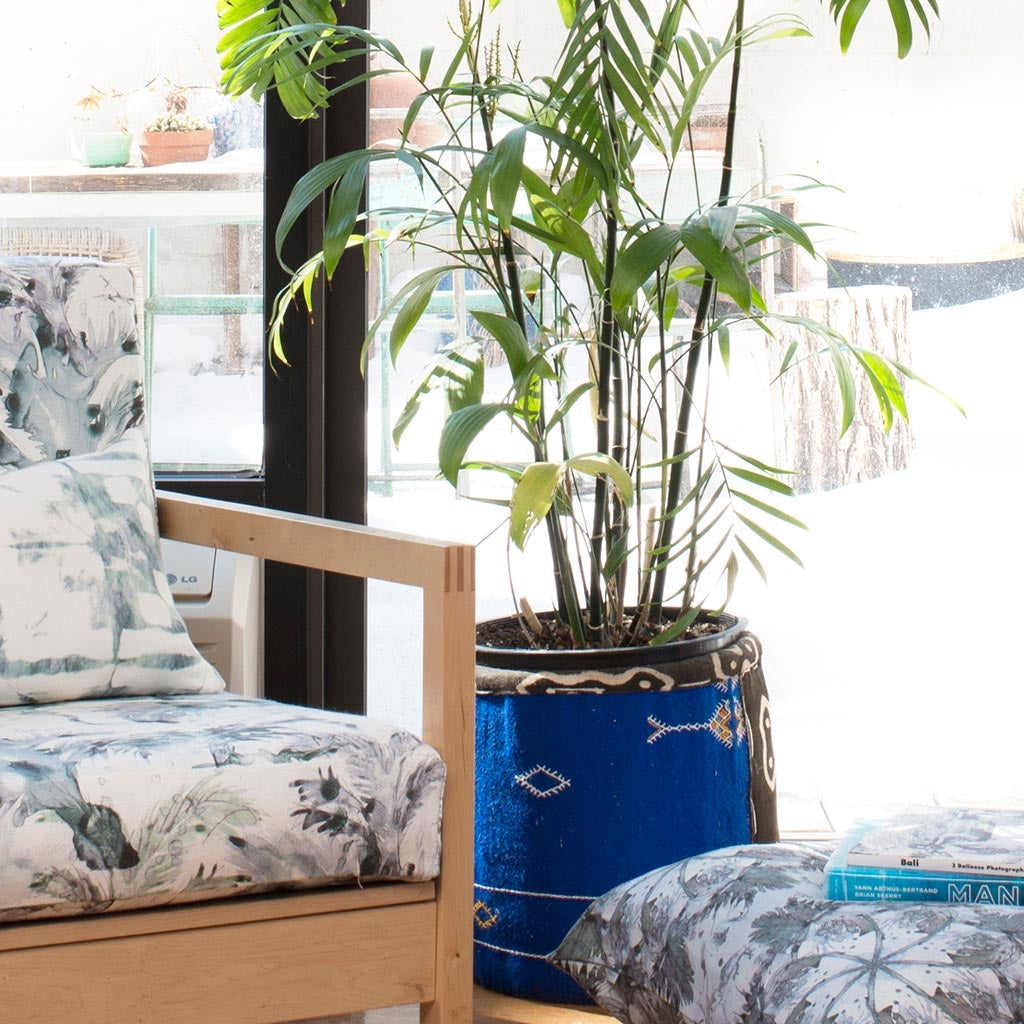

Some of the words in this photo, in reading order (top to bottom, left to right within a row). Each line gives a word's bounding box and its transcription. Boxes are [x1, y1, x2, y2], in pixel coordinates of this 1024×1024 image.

[900, 858, 919, 867] Bali
[874, 885, 938, 894] ARTHUS-BERTRAND
[947, 883, 1020, 906] MAN
